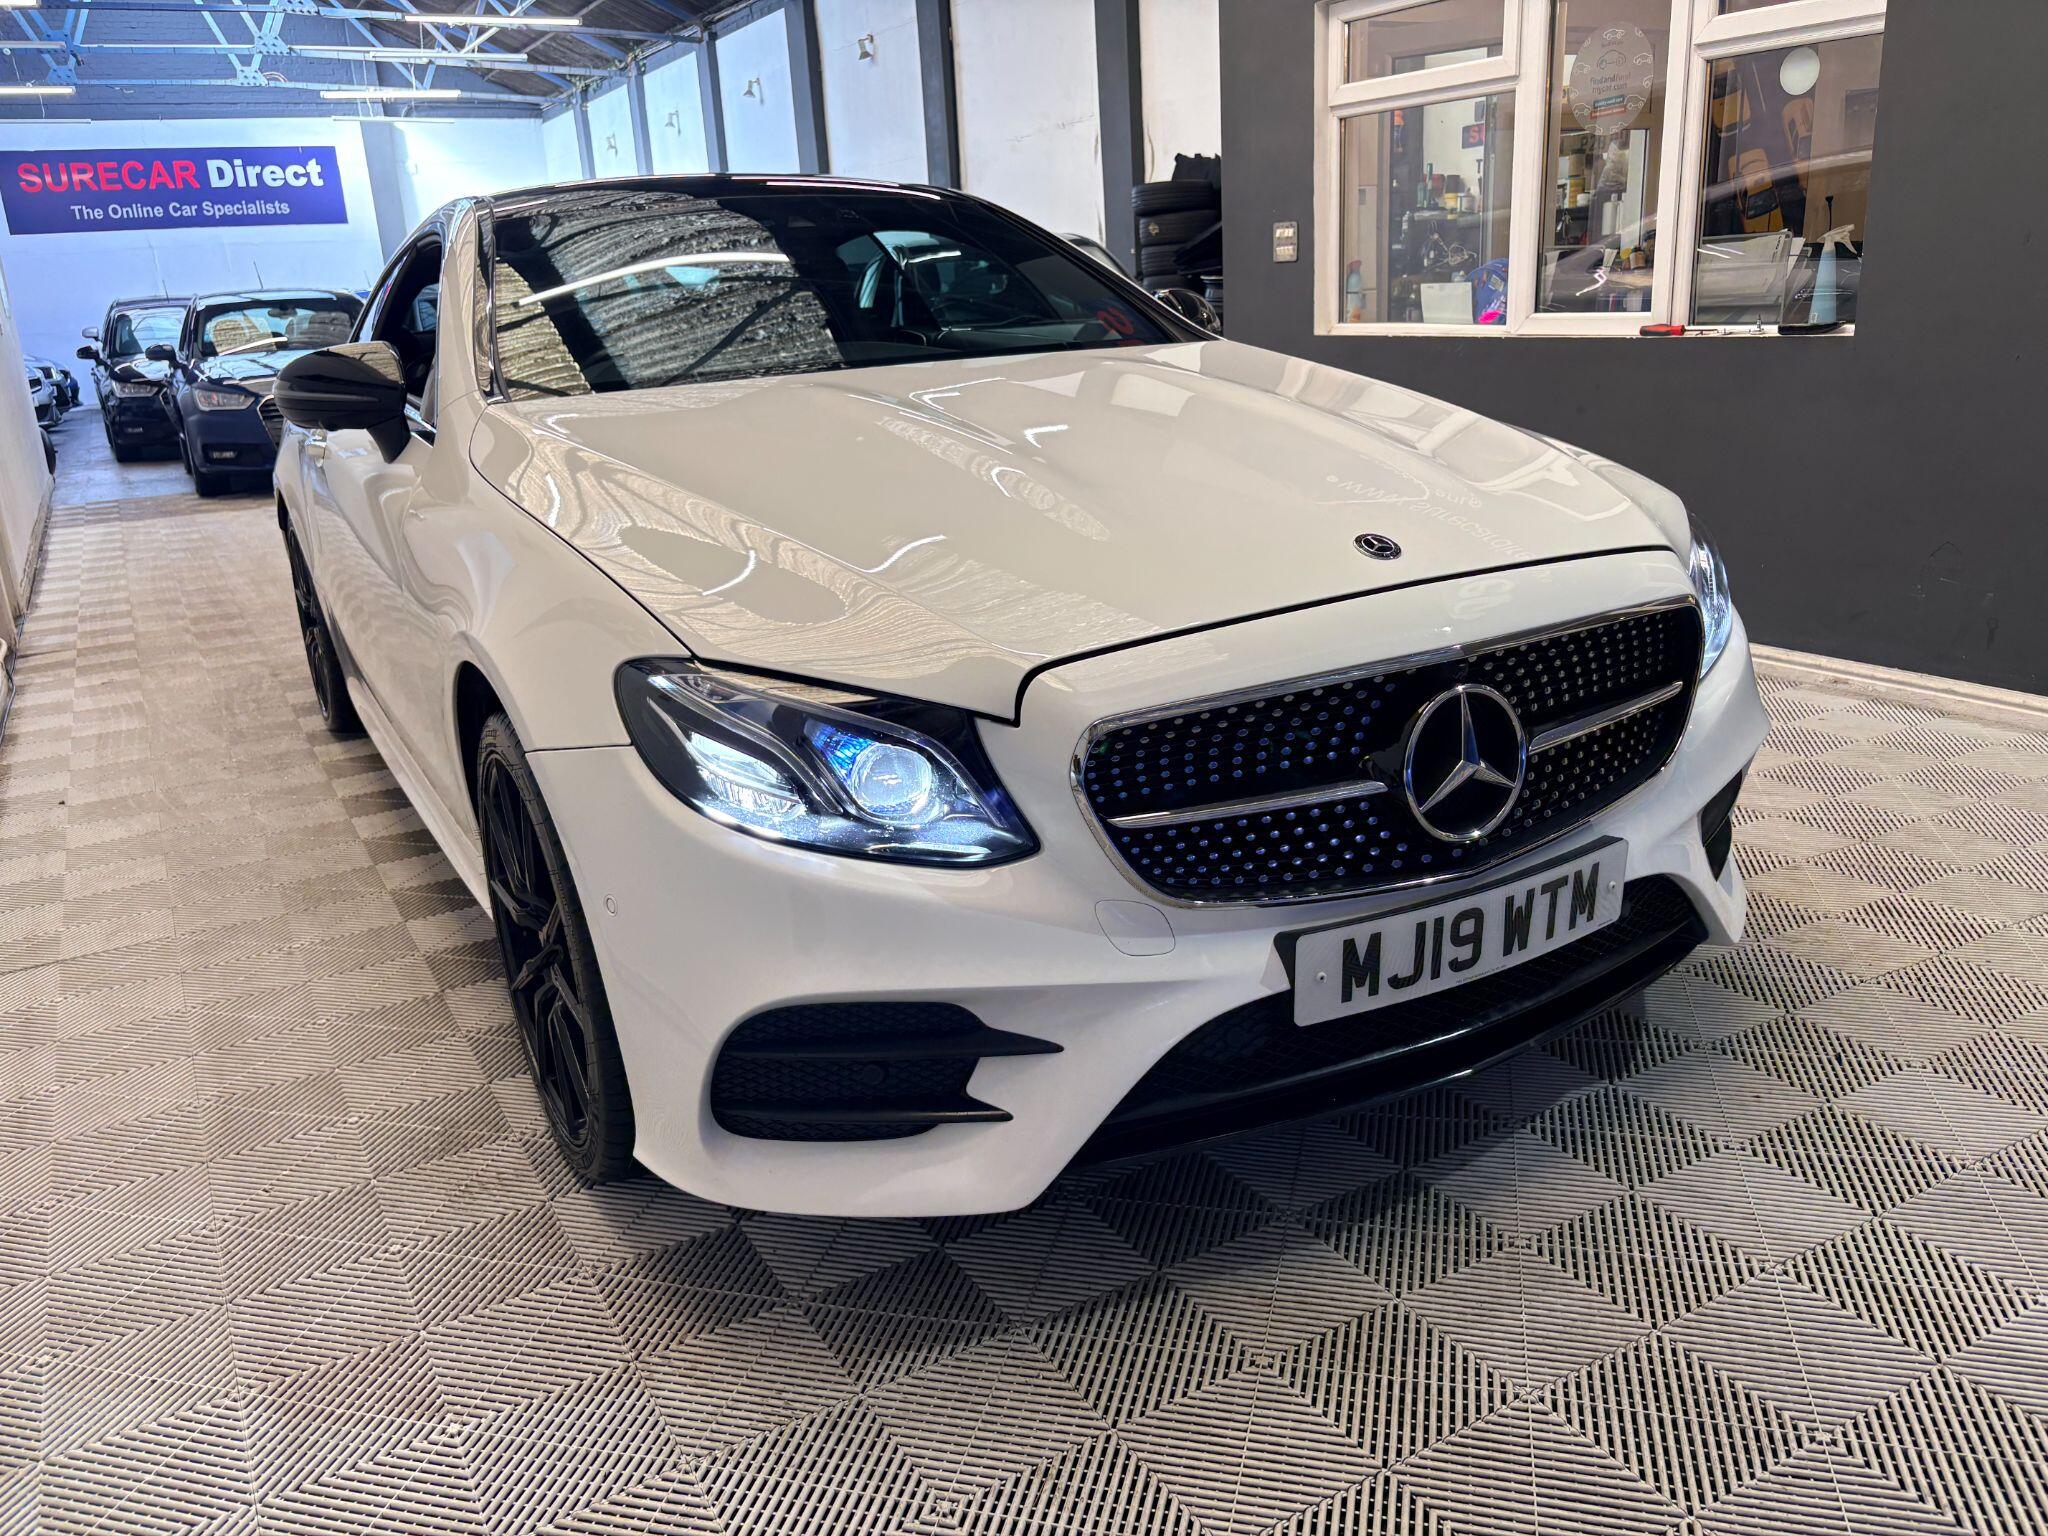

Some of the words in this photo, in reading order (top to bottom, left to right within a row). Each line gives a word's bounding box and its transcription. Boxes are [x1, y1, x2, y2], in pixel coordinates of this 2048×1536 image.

[18, 160, 200, 193] SURECAR
[206, 157, 324, 188] Direct
[71, 204, 104, 220] The
[107, 201, 164, 219] Online
[168, 201, 198, 217] Car
[202, 199, 290, 217] Specialists
[1340, 907, 1485, 1004] MJ19
[1502, 861, 1600, 957] WTM
